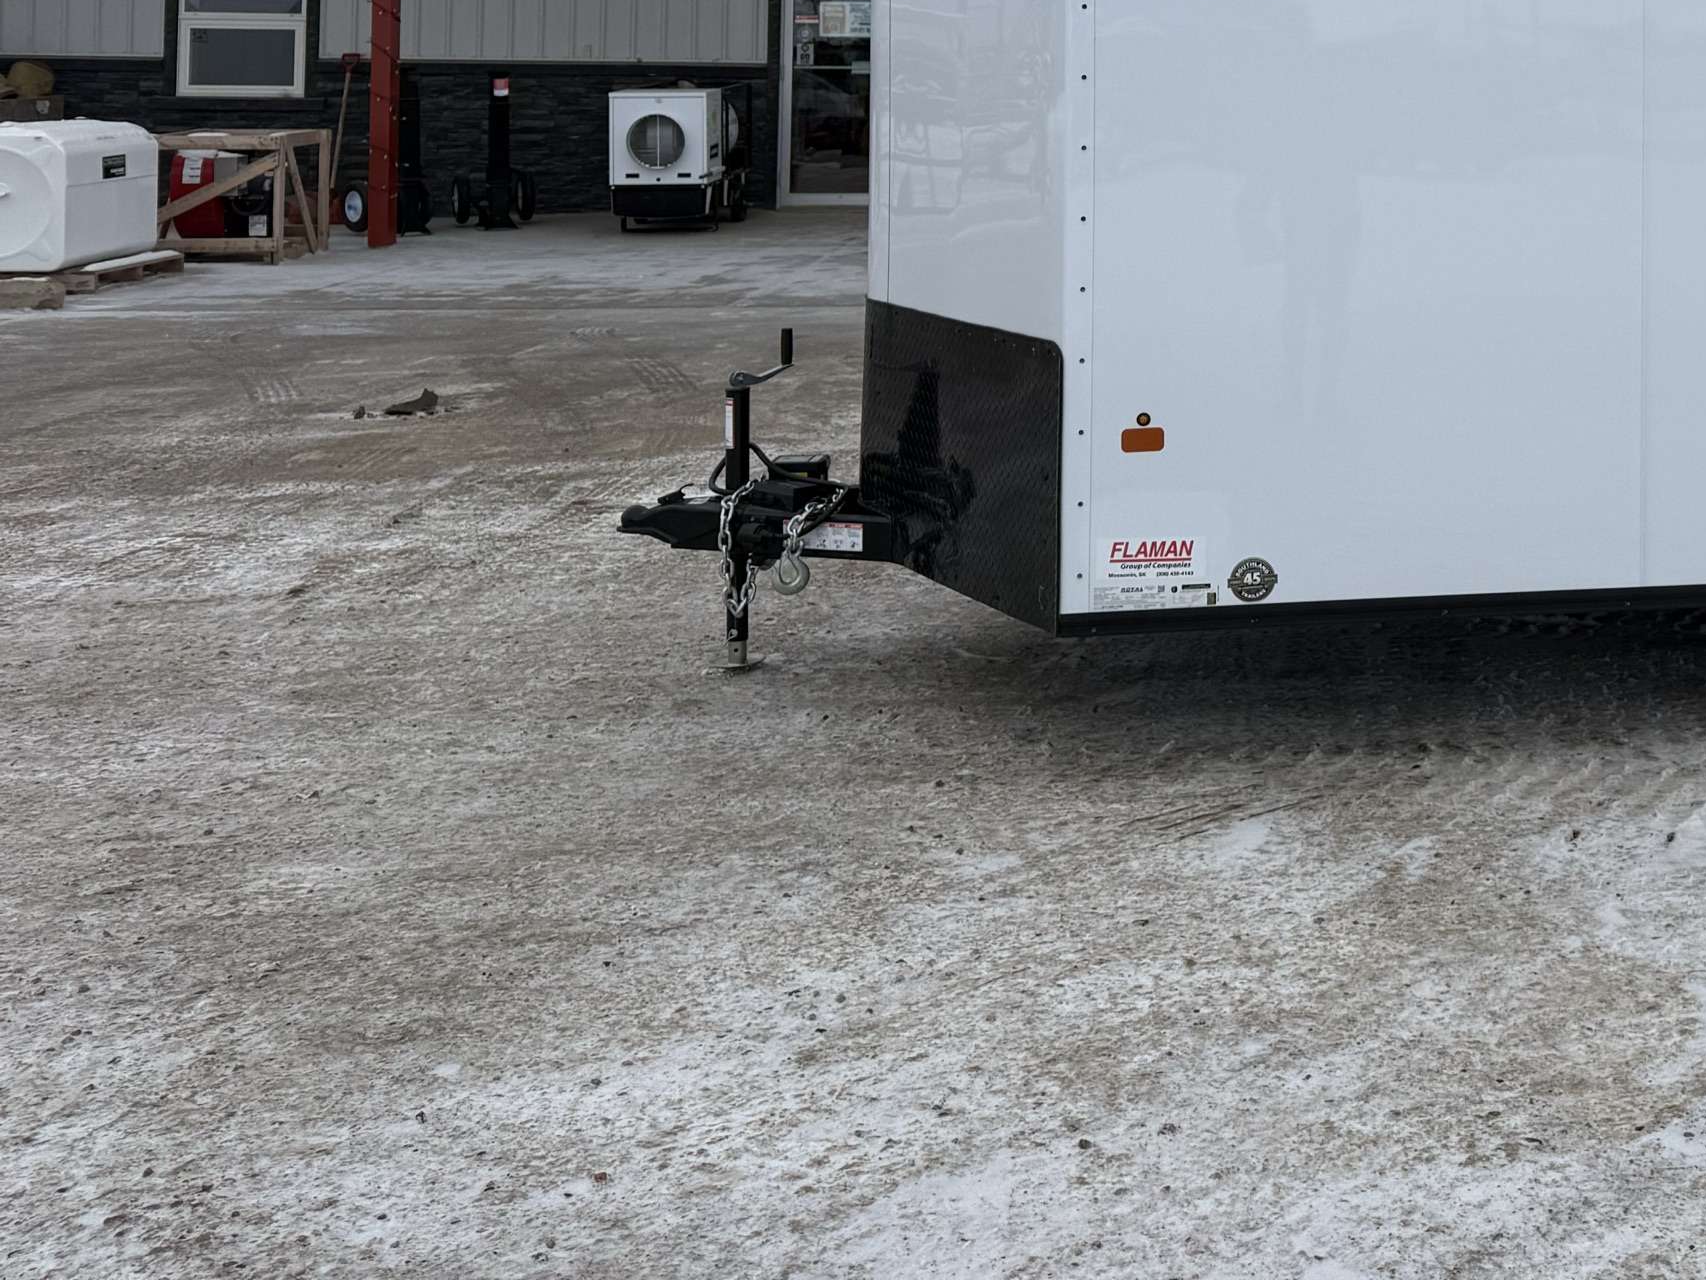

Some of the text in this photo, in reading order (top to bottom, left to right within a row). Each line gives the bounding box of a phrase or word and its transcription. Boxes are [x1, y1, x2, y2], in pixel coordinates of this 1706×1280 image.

[1110, 540, 1194, 558] FLAMAN
[1152, 562, 1191, 570] Companies
[1243, 571, 1261, 585] 45
